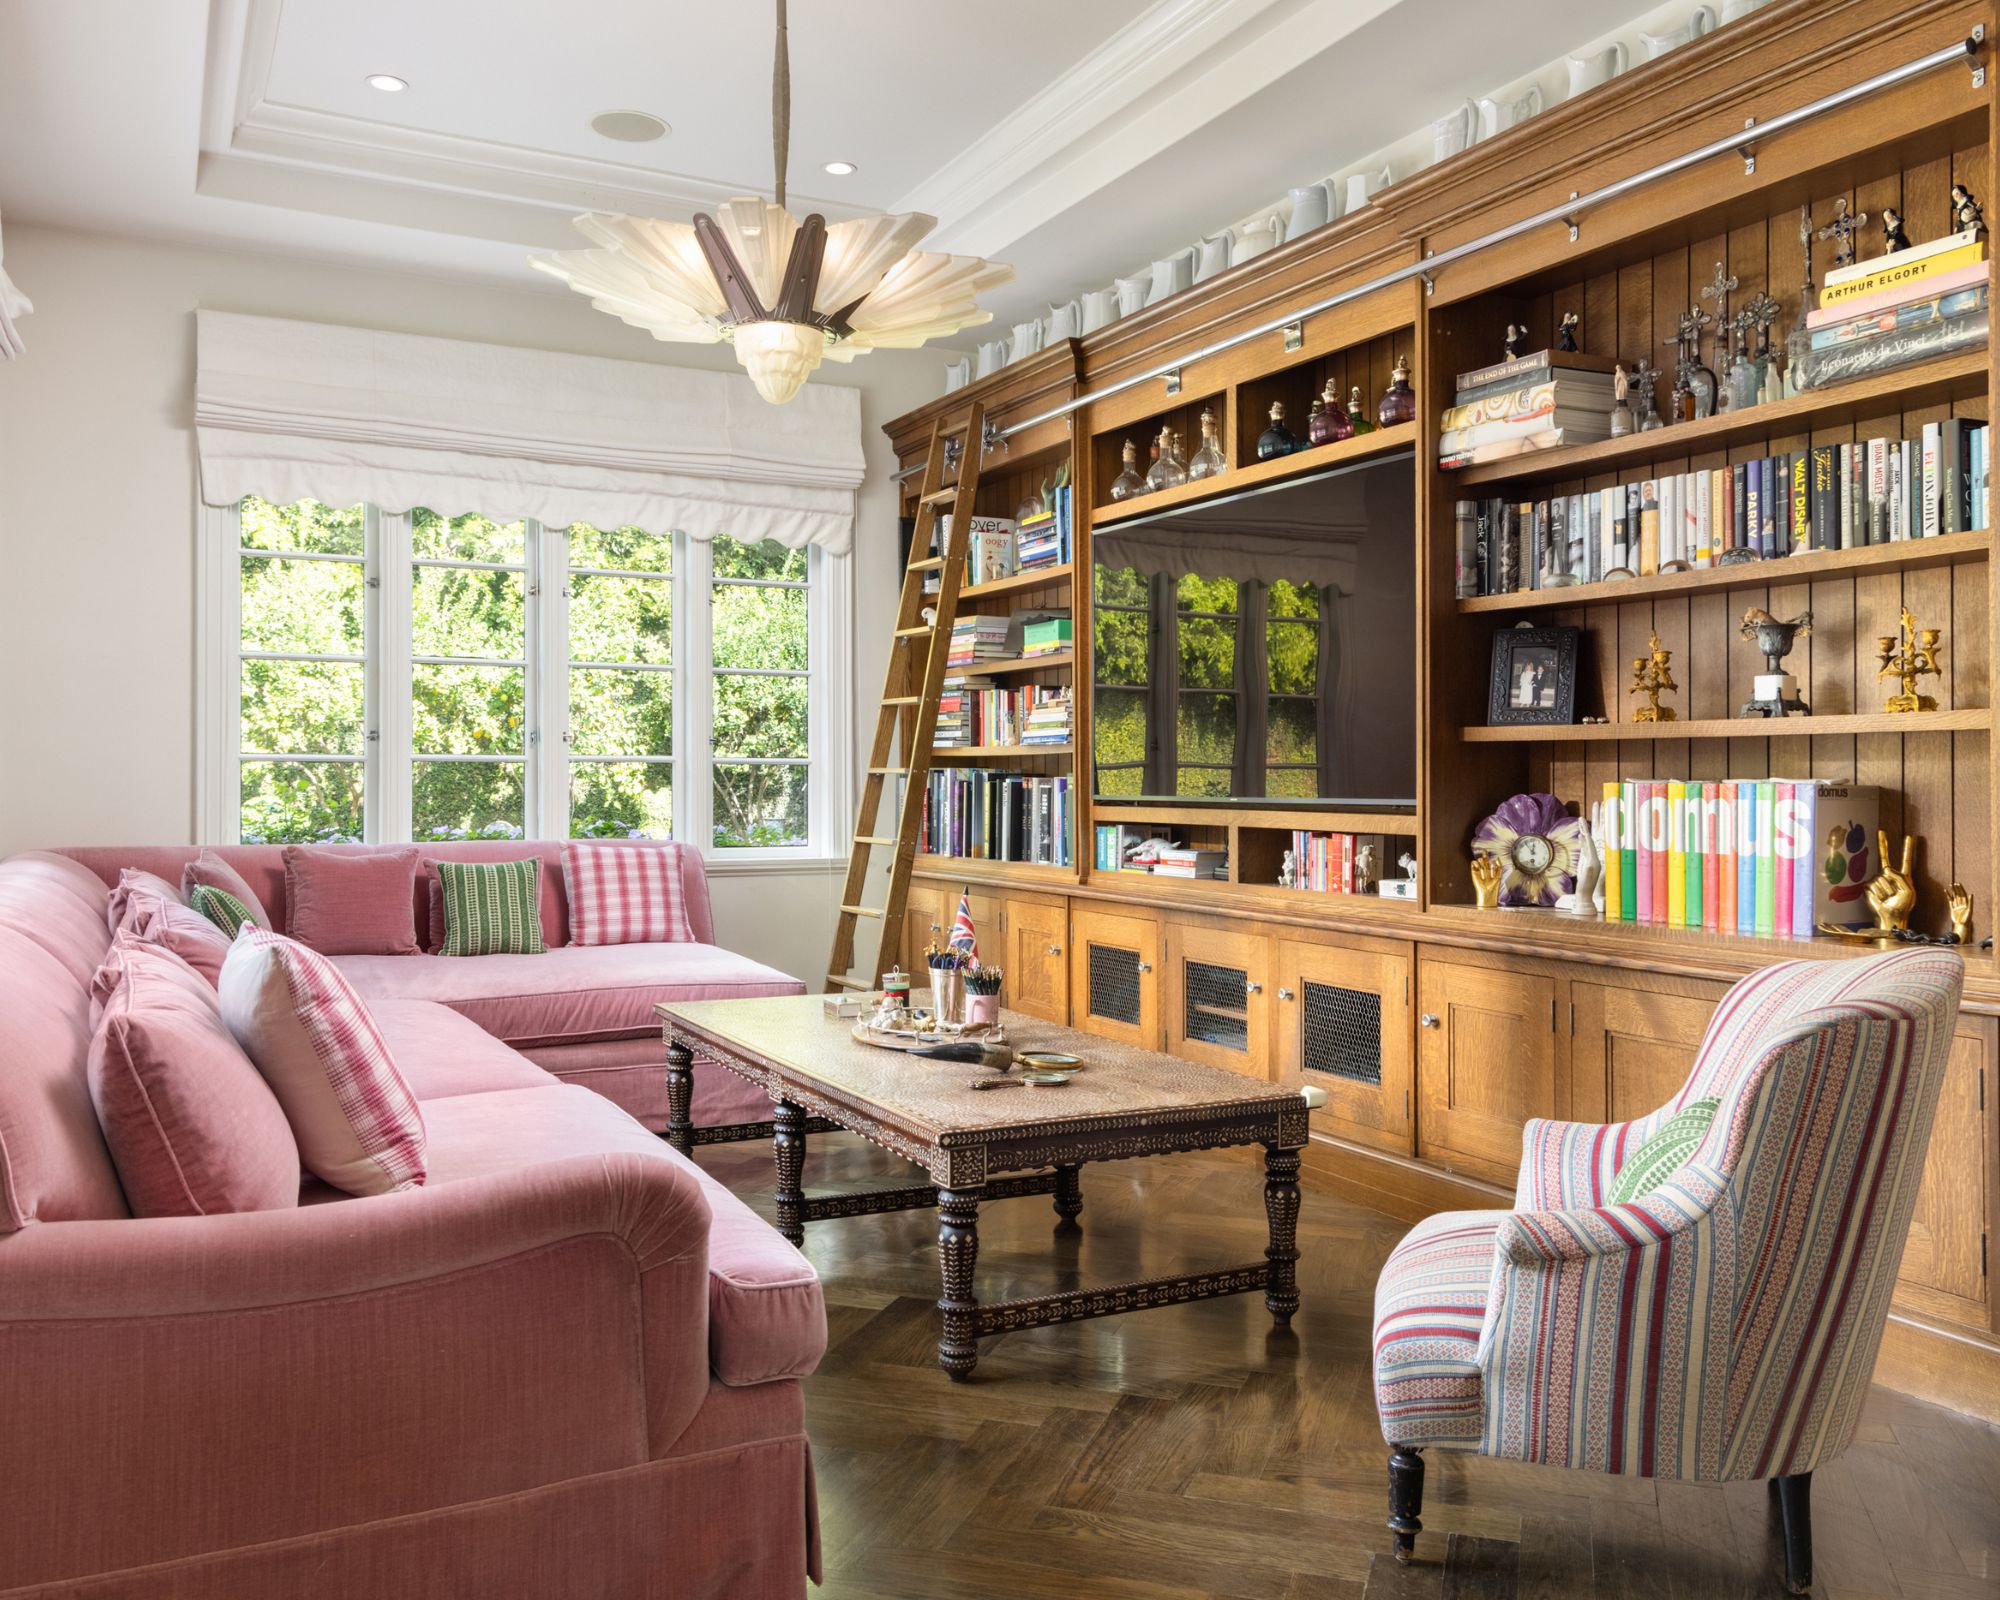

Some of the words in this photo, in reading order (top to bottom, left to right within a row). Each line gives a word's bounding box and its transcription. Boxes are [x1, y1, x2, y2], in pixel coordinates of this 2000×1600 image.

[1827, 280, 1874, 301] ARTHUR
[1879, 264, 1928, 285] ELGORT
[1821, 348, 1873, 371] Leonardo
[1877, 343, 1890, 355] da
[1894, 333, 1926, 353] Vinci
[1473, 375, 1485, 383] THE
[1485, 371, 1498, 381] END
[1498, 368, 1507, 376] OF
[1508, 364, 1520, 374] THE
[1520, 358, 1537, 369] GAME
[1813, 450, 1827, 492] Jackie
[1874, 444, 1884, 465] DIANA
[1913, 444, 1921, 466] WATCH
[1794, 457, 1806, 494] WALT
[1874, 467, 1884, 496] MOSLEY
[1913, 467, 1921, 477] ME
[1924, 451, 1935, 492] ELTON
[1945, 467, 1953, 493] Working
[1477, 515, 1485, 538] Jack
[1747, 491, 1757, 538] PARKY
[1794, 497, 1806, 543] DISNEY
[1924, 494, 1935, 531] JOHN
[985, 537, 1008, 549] oogy
[1817, 784, 1848, 798] domus
[1604, 783, 1811, 859] domus
